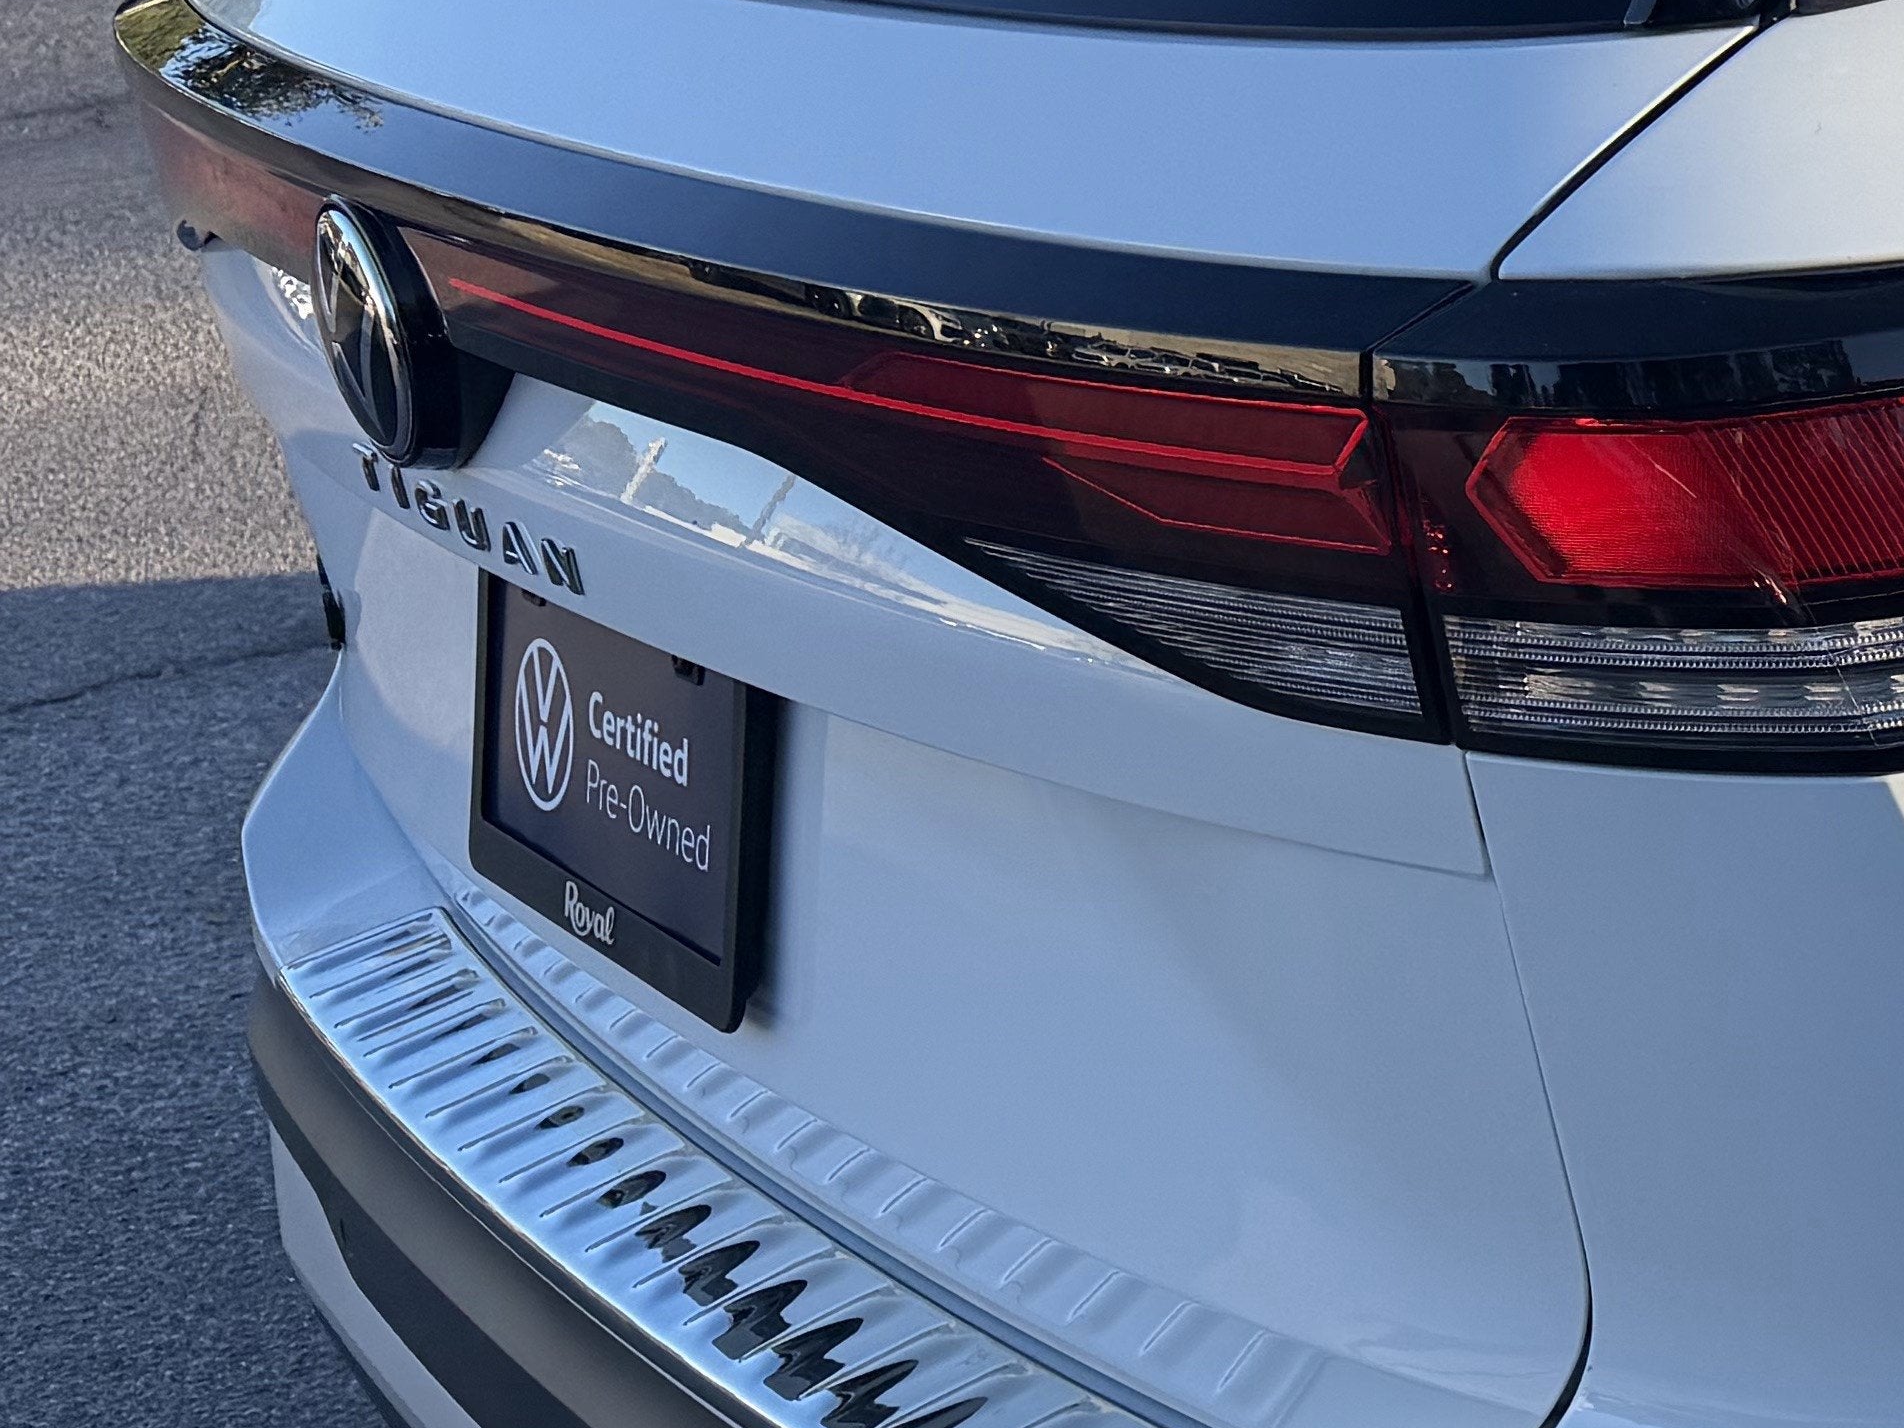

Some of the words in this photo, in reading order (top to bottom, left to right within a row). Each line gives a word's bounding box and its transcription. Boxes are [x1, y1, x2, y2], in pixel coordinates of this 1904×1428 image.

[352, 442, 586, 596] TIGUAN
[588, 690, 689, 788] Certified
[585, 758, 711, 872] Pre-Owned
[564, 880, 616, 945] Royal
